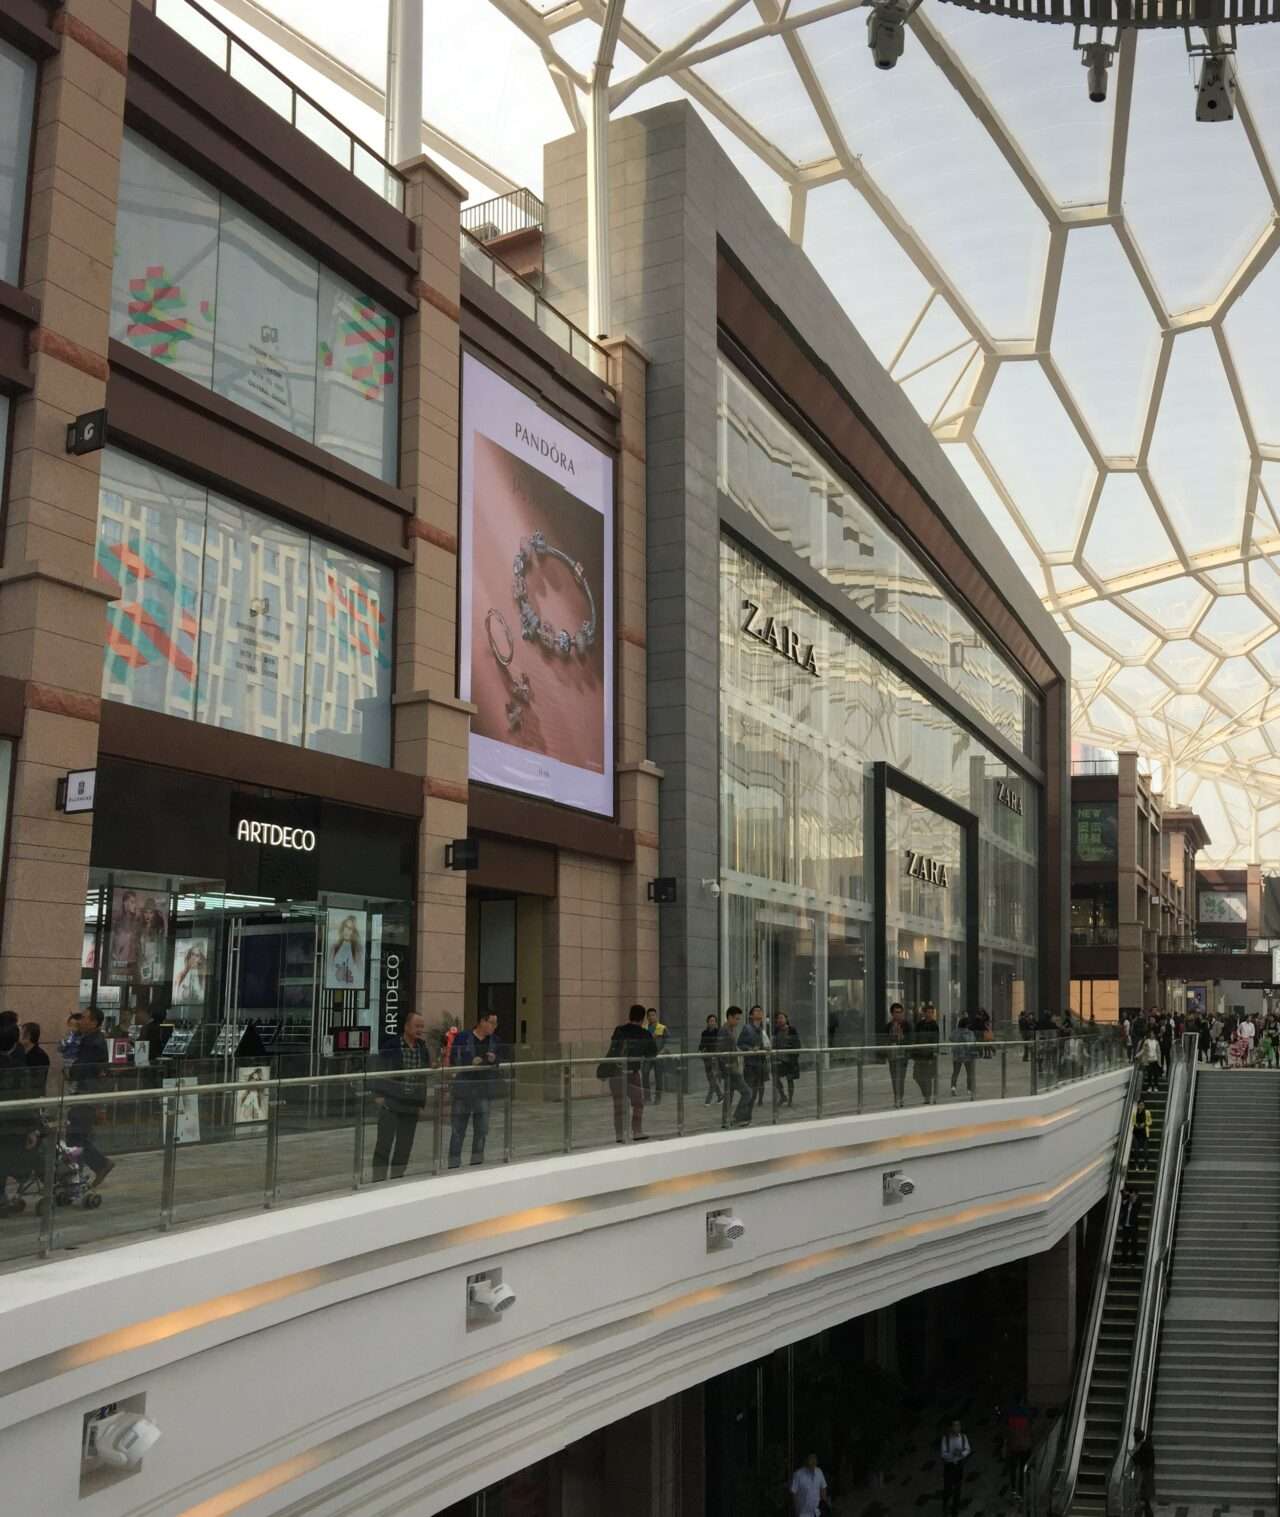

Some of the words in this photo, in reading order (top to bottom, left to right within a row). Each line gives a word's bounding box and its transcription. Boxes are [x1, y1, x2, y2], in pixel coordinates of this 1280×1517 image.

[515, 422, 575, 475] PANDORA
[741, 600, 820, 677] ZARA
[996, 781, 1024, 816] ZARA
[238, 819, 315, 851] ARTDECO
[905, 850, 949, 888] ZARA
[385, 954, 400, 1036] ARTDECO
